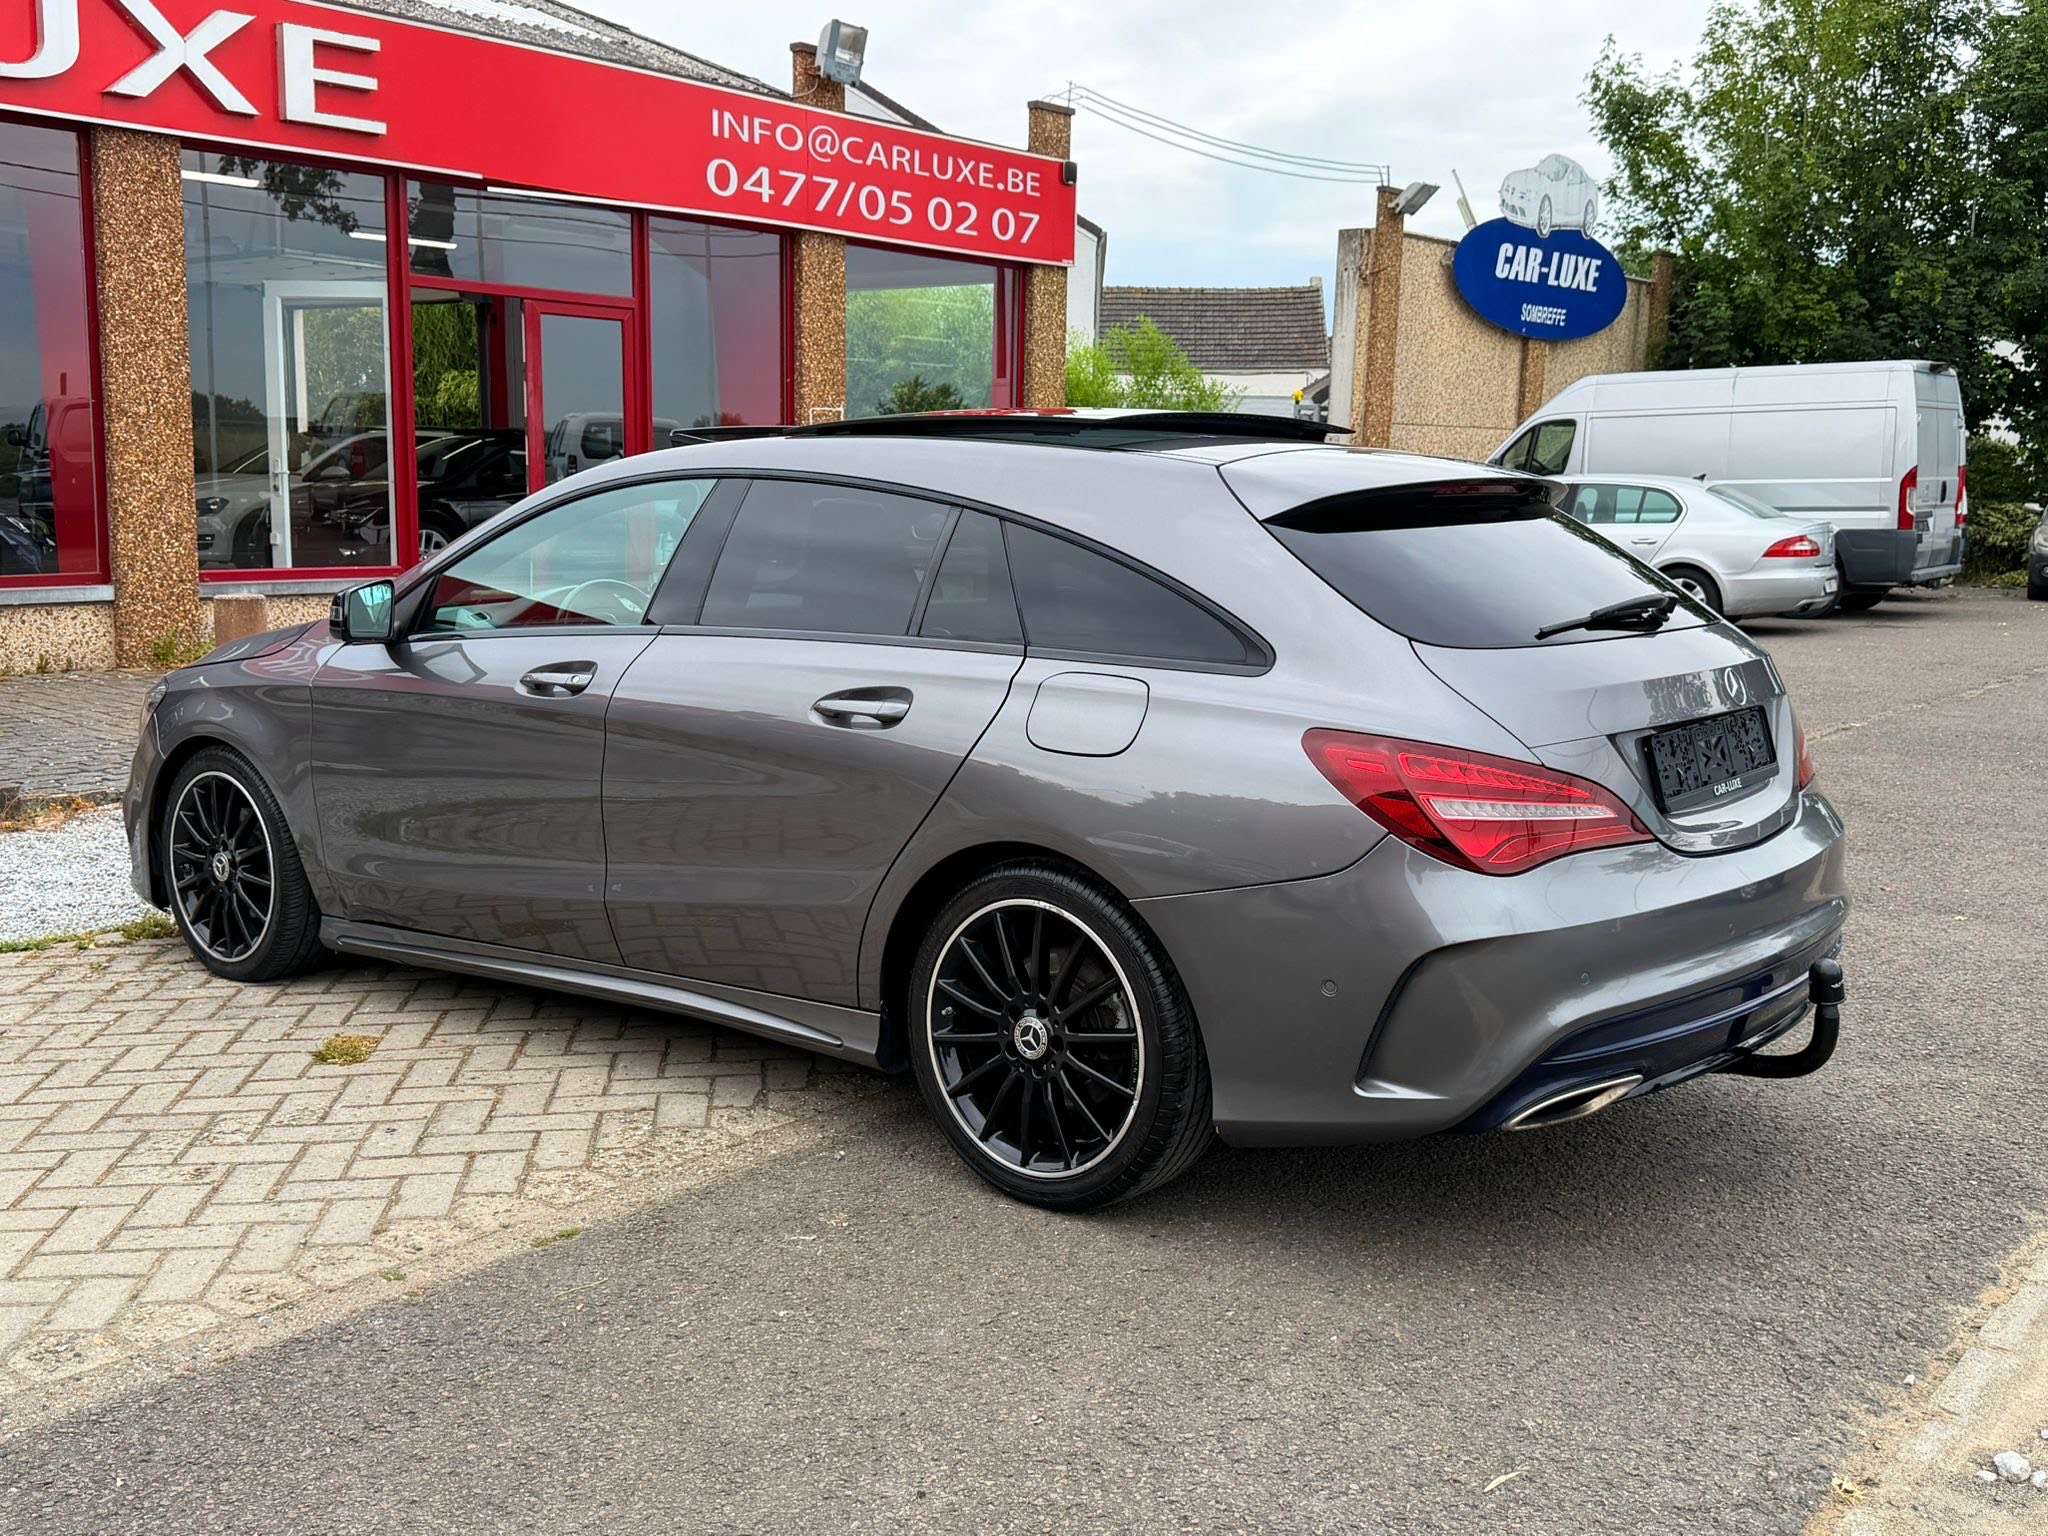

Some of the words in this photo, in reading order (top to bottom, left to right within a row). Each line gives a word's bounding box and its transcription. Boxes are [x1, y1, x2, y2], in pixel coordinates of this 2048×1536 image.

[711, 108, 1041, 197] INFO@CARLUXE.BE
[705, 158, 913, 226] 0477/05
[927, 197, 979, 236] 02
[991, 208, 1041, 244] 07
[1495, 242, 1602, 292] CAR-LUXE
[1520, 303, 1567, 326] SOMBREFFE
[1714, 777, 1742, 796] CAR-LUXE
